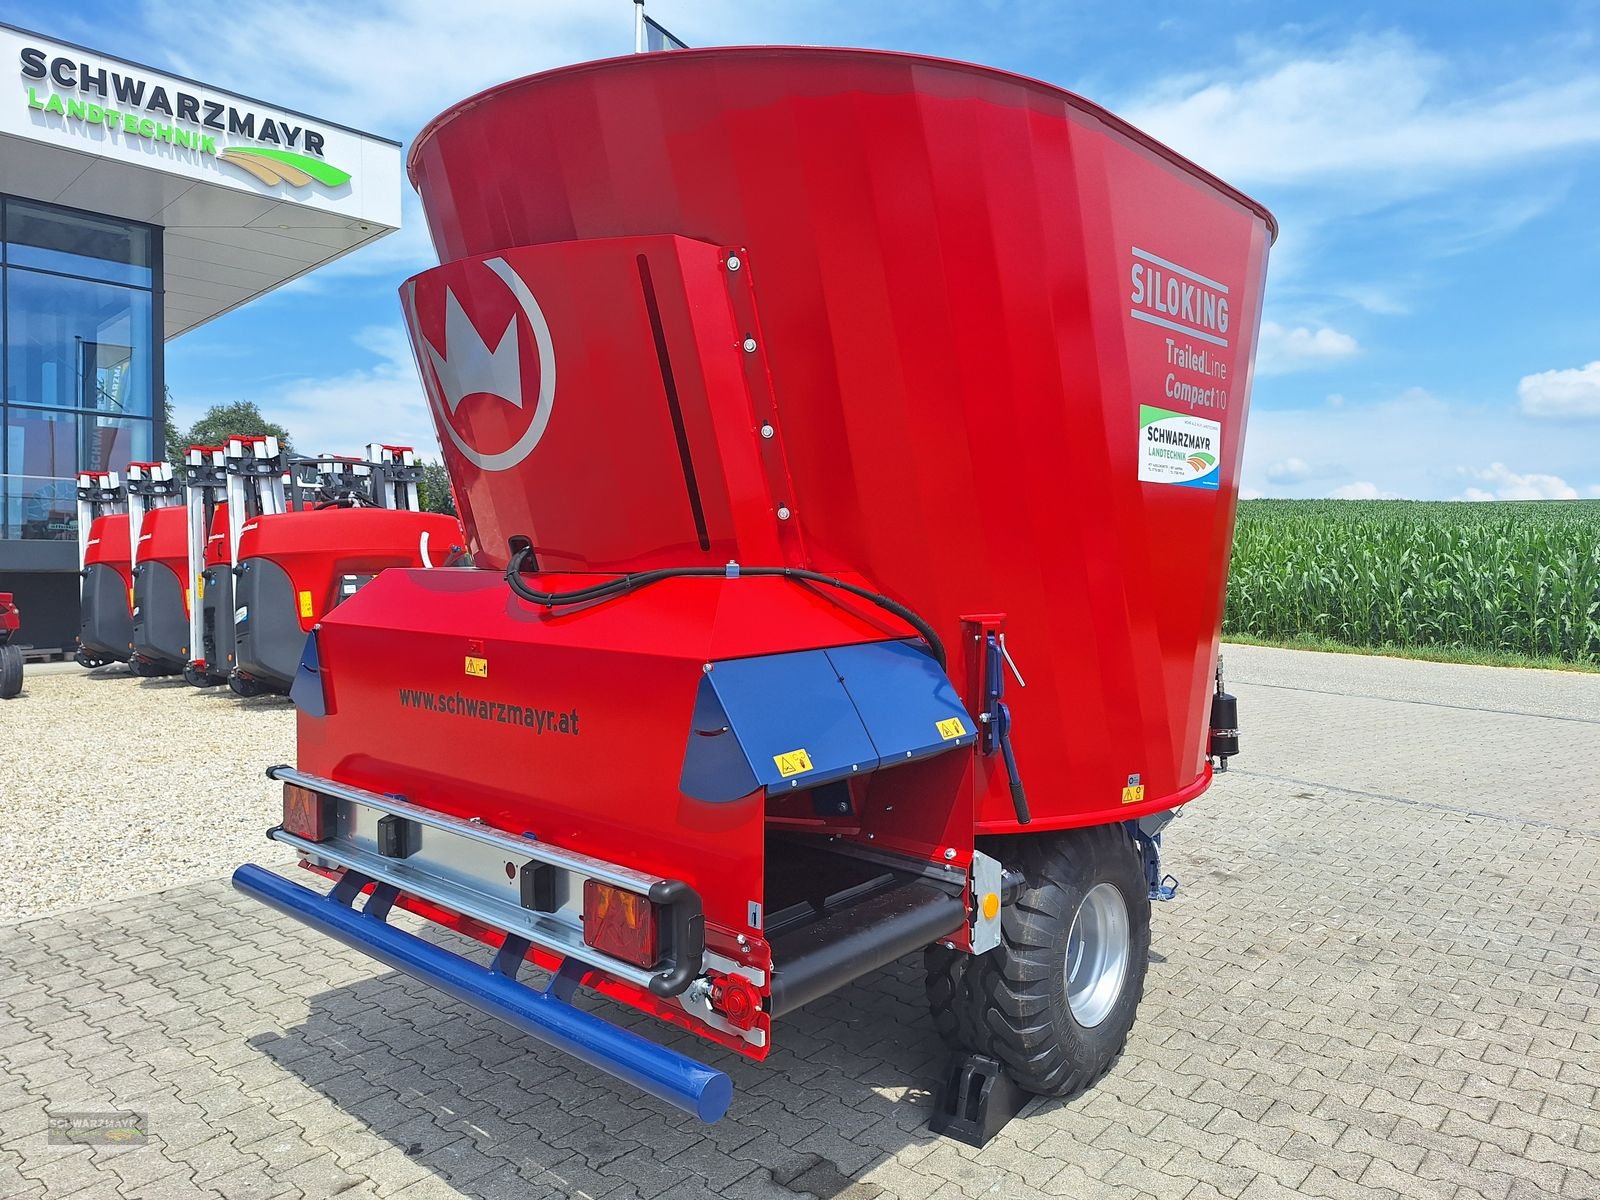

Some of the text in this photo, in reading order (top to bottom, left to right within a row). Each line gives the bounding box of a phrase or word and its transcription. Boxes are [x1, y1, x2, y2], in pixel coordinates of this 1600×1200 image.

[20, 47, 325, 157] SCHWARZMAYR
[27, 87, 217, 155] LANDTECHNIK
[1131, 263, 1229, 334] SILOKING
[1165, 338, 1227, 380] TrailedLine
[1165, 372, 1227, 410] Compact10
[1147, 425, 1211, 451] SCHWARZMAYR
[1148, 446, 1187, 461] LANDTECHNIK
[399, 687, 580, 736] www.schwarzmayr.at
